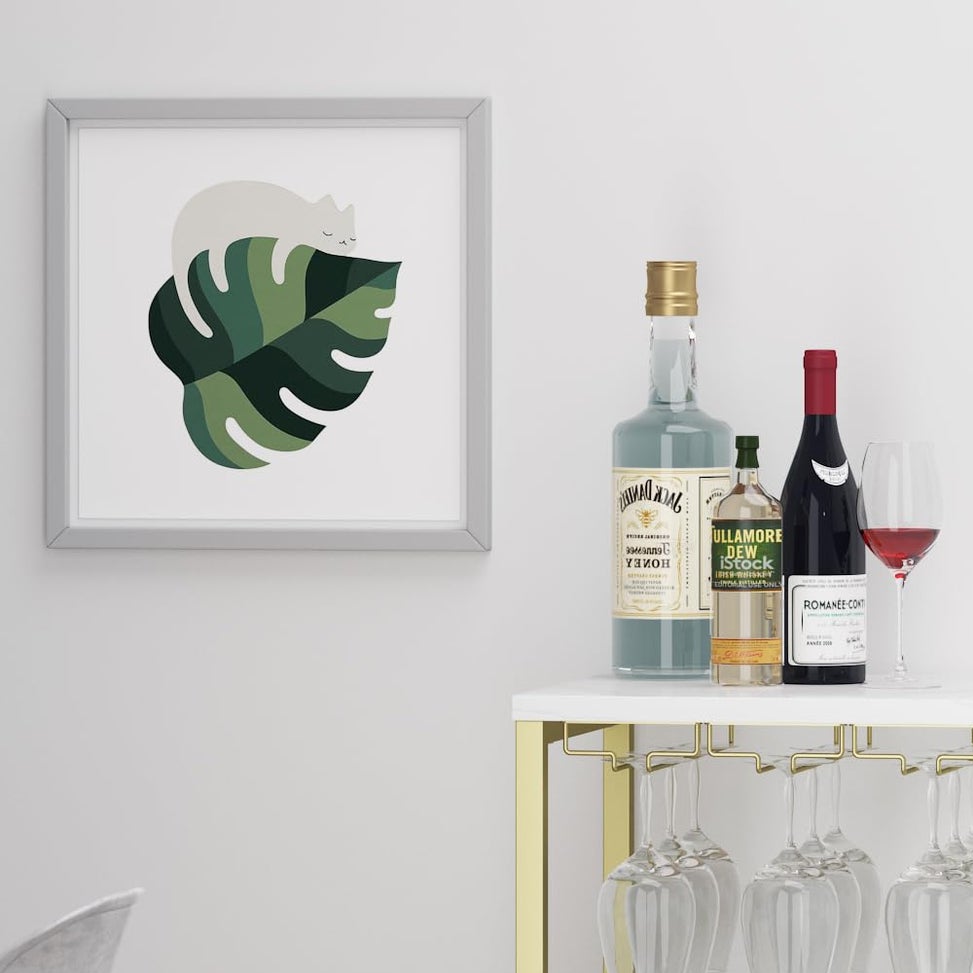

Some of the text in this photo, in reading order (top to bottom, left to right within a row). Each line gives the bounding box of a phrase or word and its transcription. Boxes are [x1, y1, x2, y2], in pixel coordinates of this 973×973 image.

[712, 525, 783, 543] ULLAMORE
[727, 545, 757, 559] DEW
[720, 555, 774, 570] iStock
